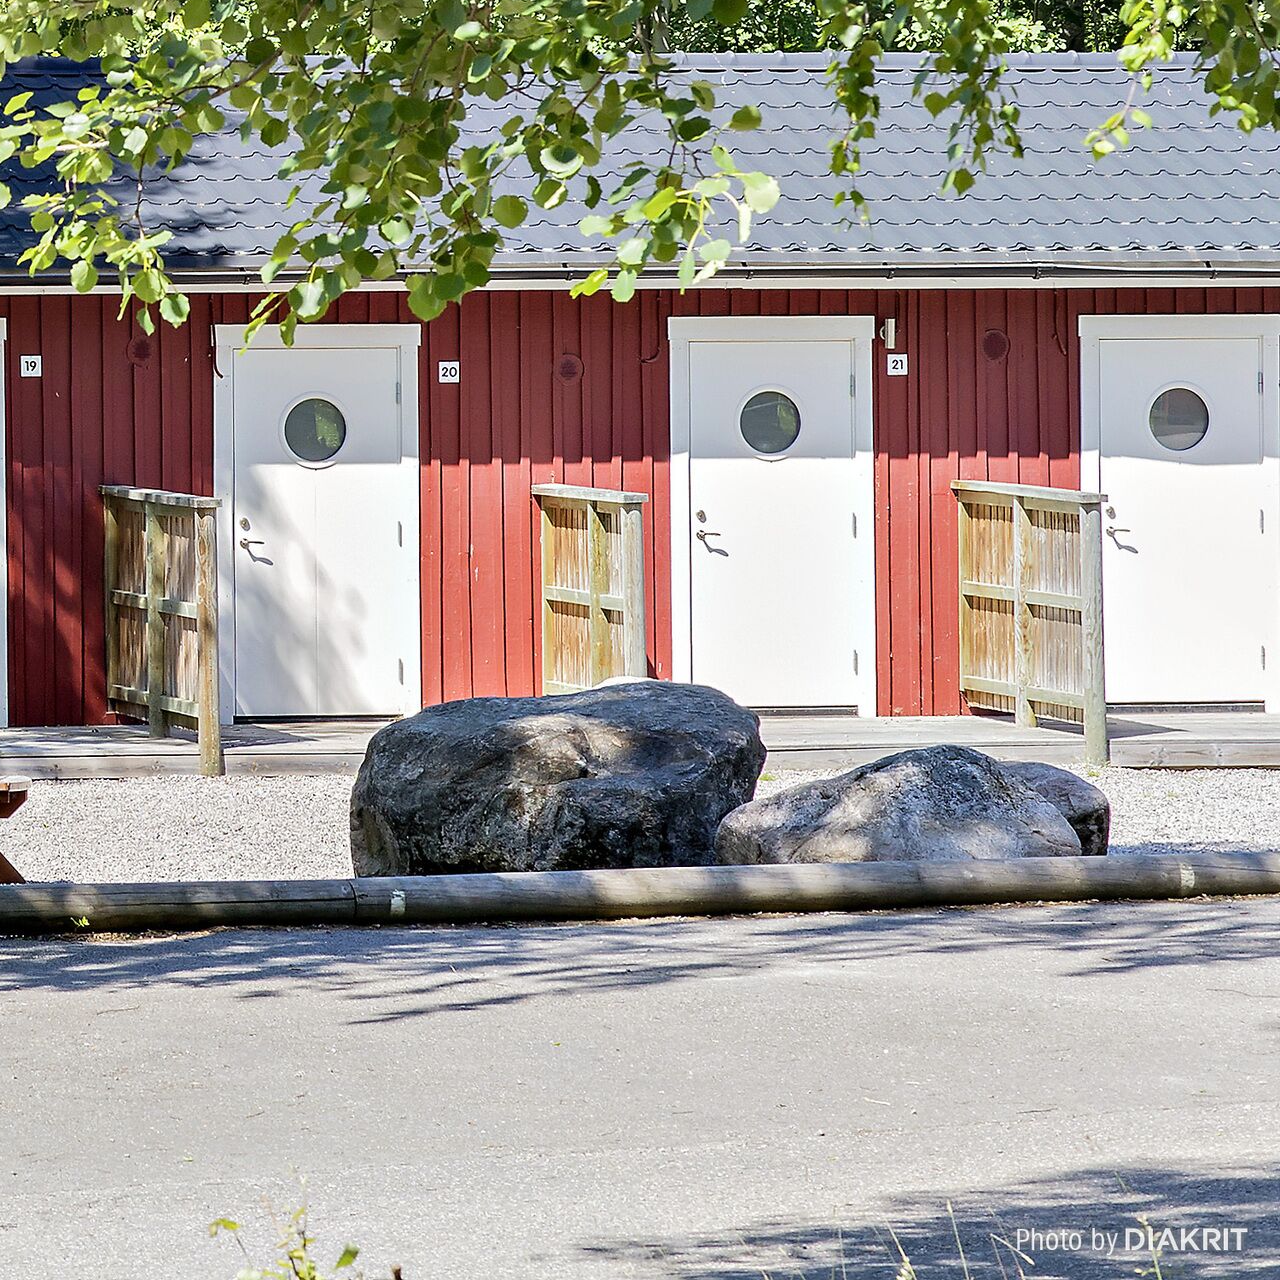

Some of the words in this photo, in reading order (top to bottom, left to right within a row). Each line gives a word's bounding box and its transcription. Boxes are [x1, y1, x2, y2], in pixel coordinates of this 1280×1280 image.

[24, 360, 37, 372] 19
[891, 359, 904, 370] 21
[441, 366, 458, 378] 20
